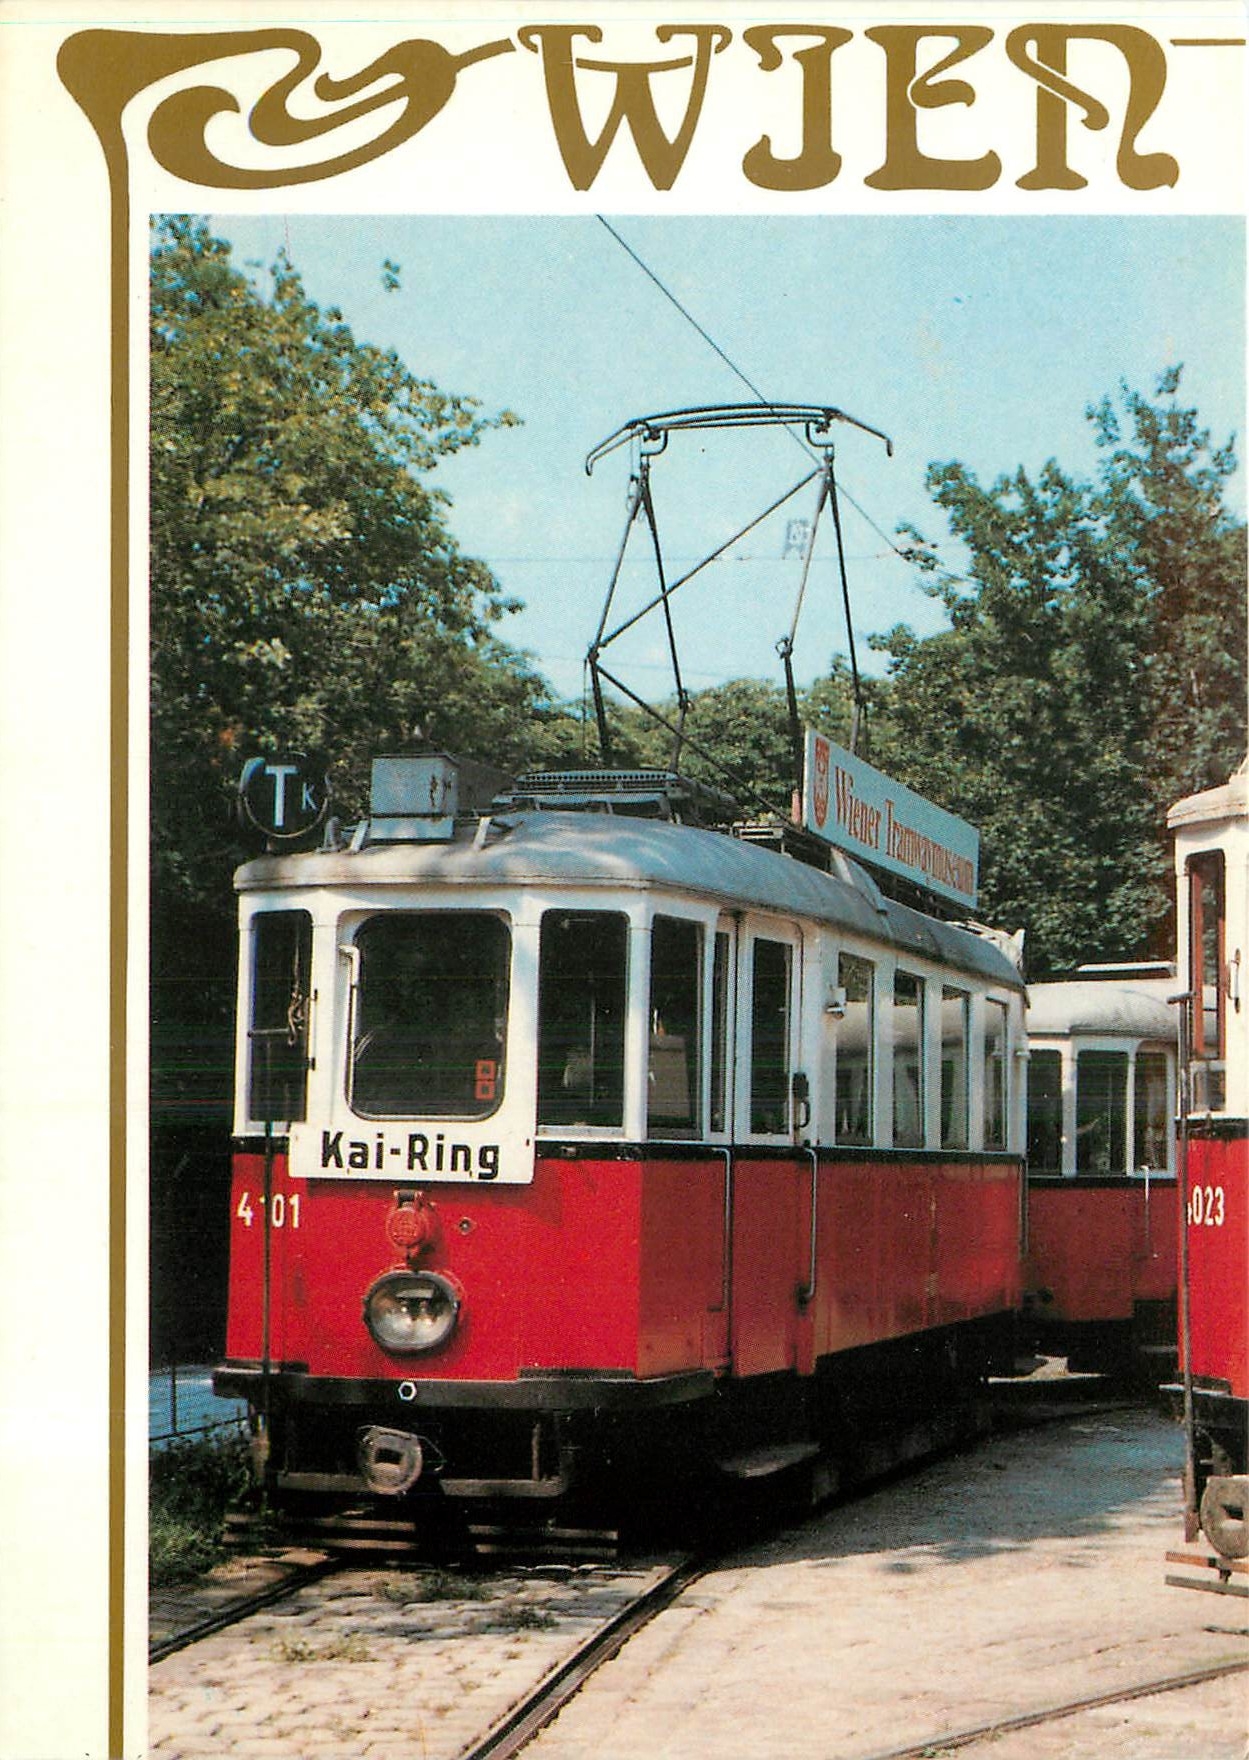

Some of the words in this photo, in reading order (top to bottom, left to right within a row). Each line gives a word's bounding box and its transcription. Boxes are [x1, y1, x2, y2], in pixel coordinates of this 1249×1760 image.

[835, 765, 881, 849] Wiener
[321, 1130, 500, 1180] Kai-Ring
[237, 1191, 300, 1229] 401
